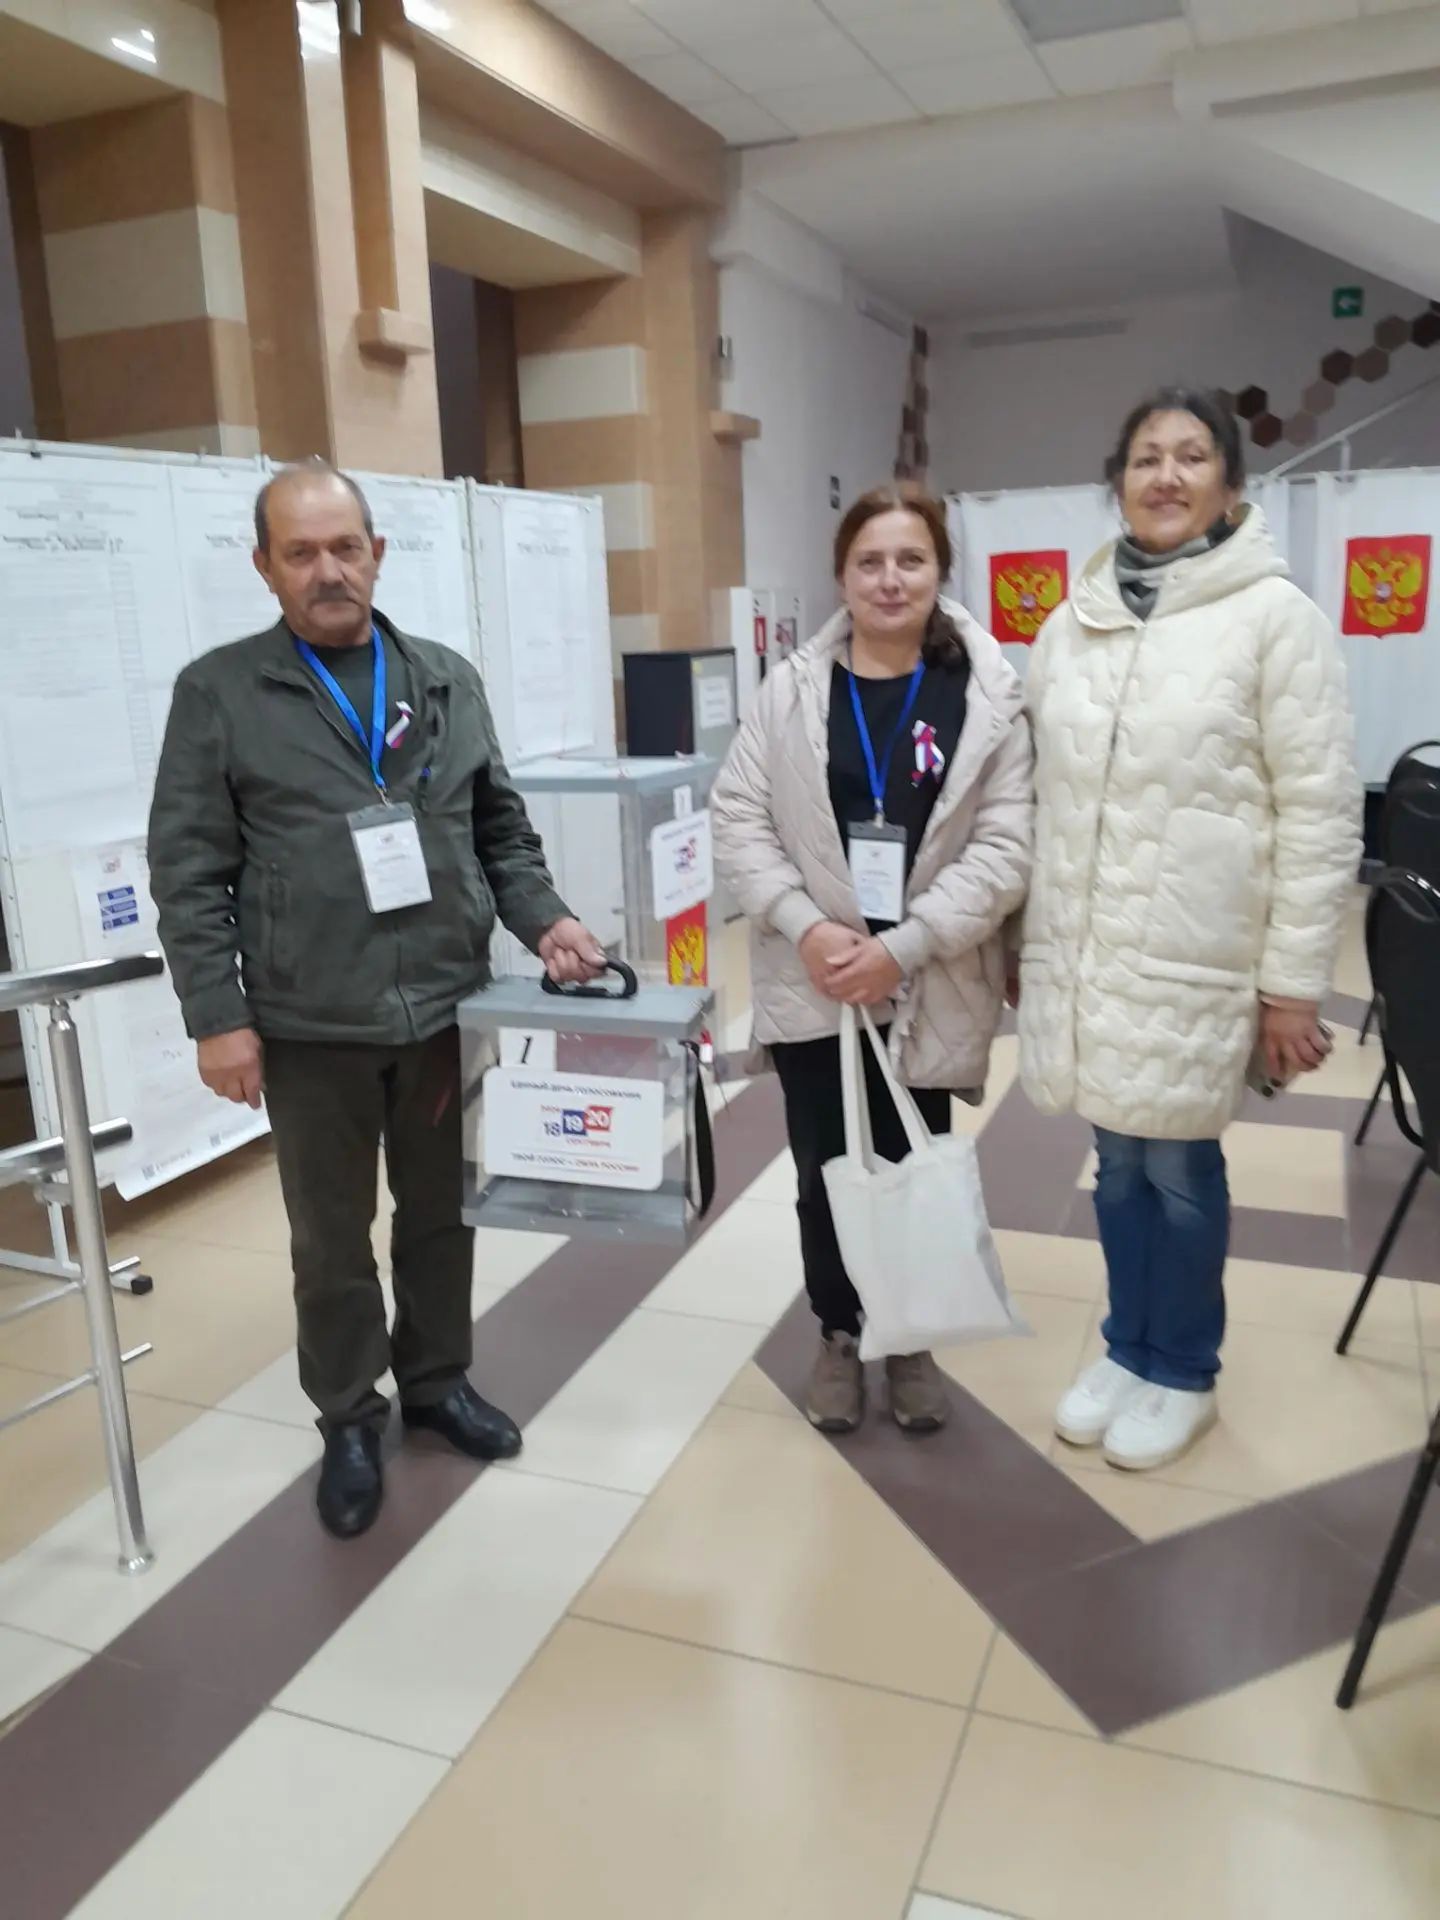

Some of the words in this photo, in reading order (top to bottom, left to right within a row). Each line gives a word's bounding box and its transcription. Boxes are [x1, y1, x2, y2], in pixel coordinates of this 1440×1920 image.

[521, 1036, 532, 1064] 1
[543, 1120, 561, 1137] 18
[565, 1114, 584, 1132] 19
[584, 1109, 610, 1129] 20
